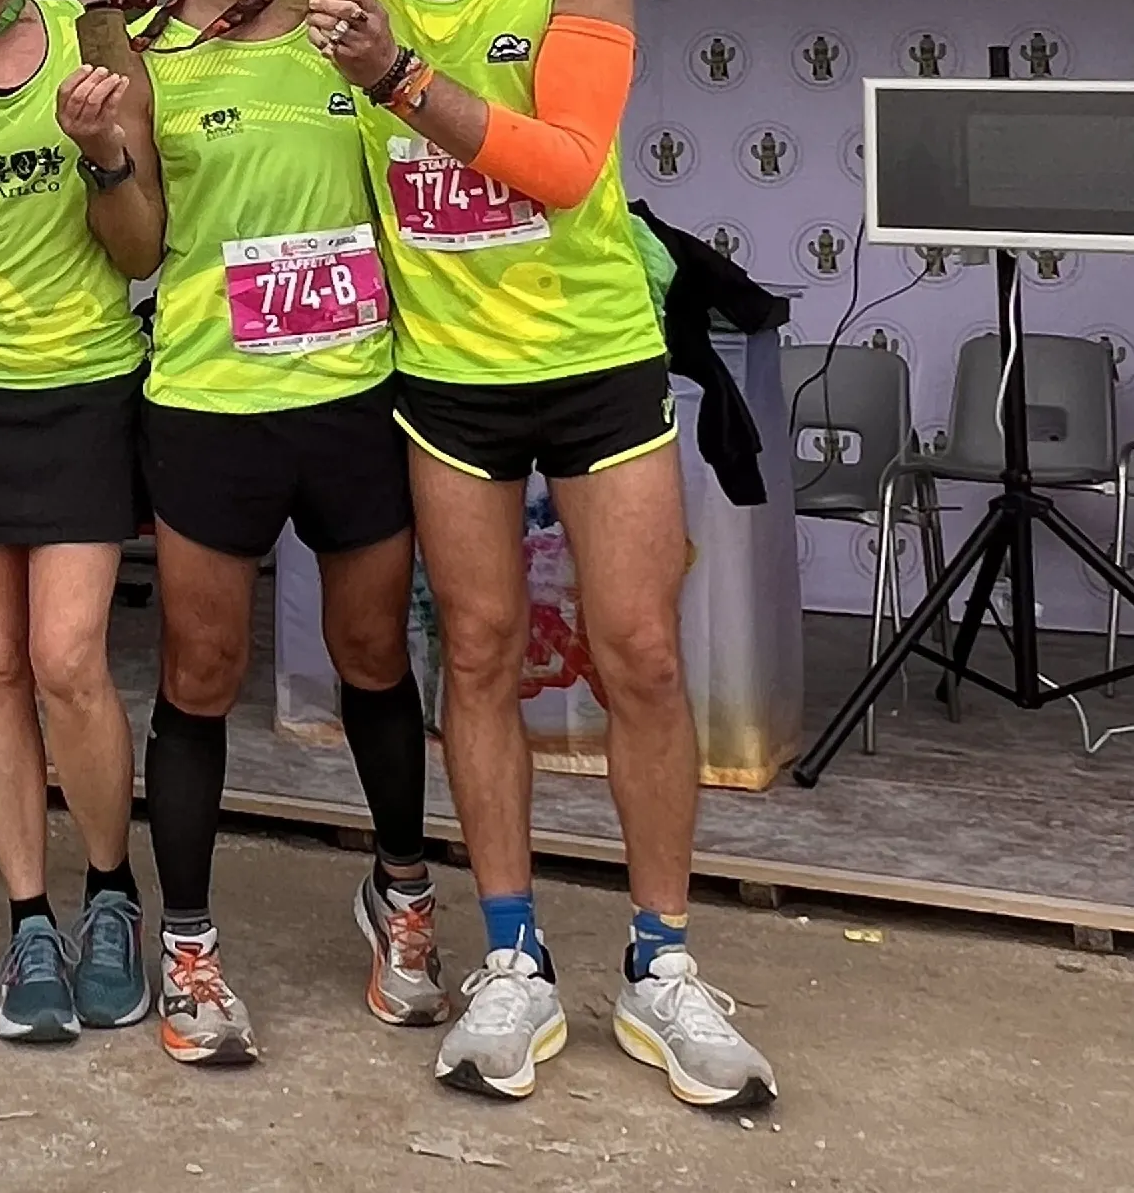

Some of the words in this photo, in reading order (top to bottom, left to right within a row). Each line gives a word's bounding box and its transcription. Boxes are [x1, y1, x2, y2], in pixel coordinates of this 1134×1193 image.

[405, 170, 510, 211] 774-D
[422, 211, 436, 230] 2
[270, 255, 338, 274] STAFFETTA
[255, 264, 357, 314] 774-B
[264, 314, 282, 334] 2
